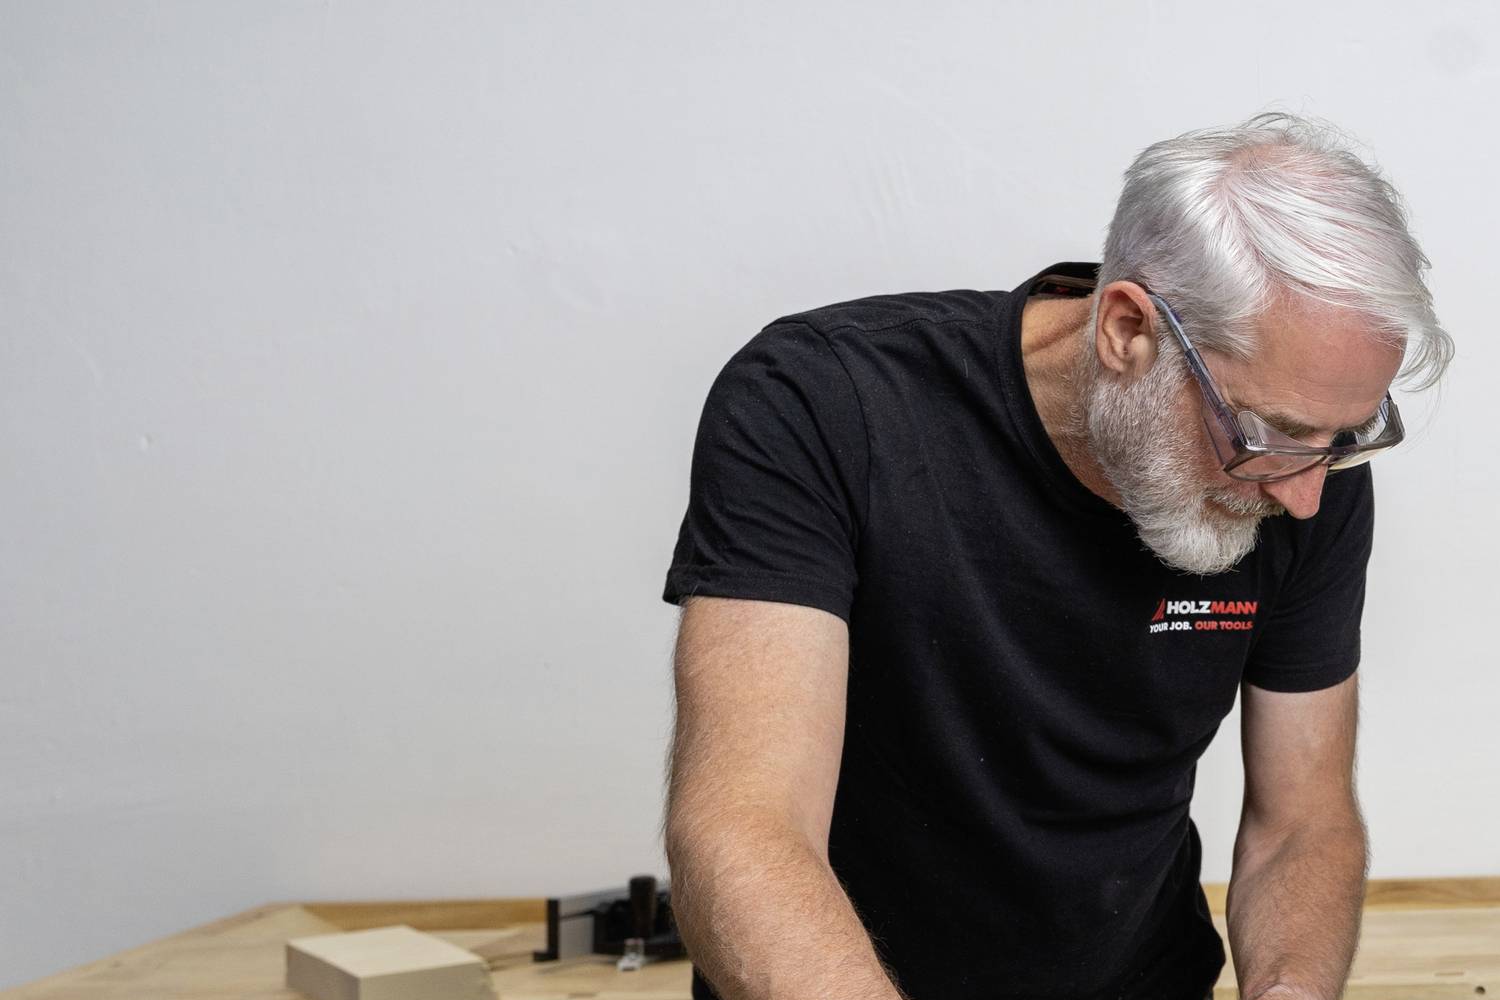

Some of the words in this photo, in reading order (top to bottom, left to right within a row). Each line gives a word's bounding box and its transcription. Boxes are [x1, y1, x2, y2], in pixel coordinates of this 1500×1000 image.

[1166, 600, 1258, 615] HOLZMANN
[1149, 622, 1168, 634] YOUR
[1169, 621, 1192, 631] JOB.
[1195, 621, 1218, 631] OUR
